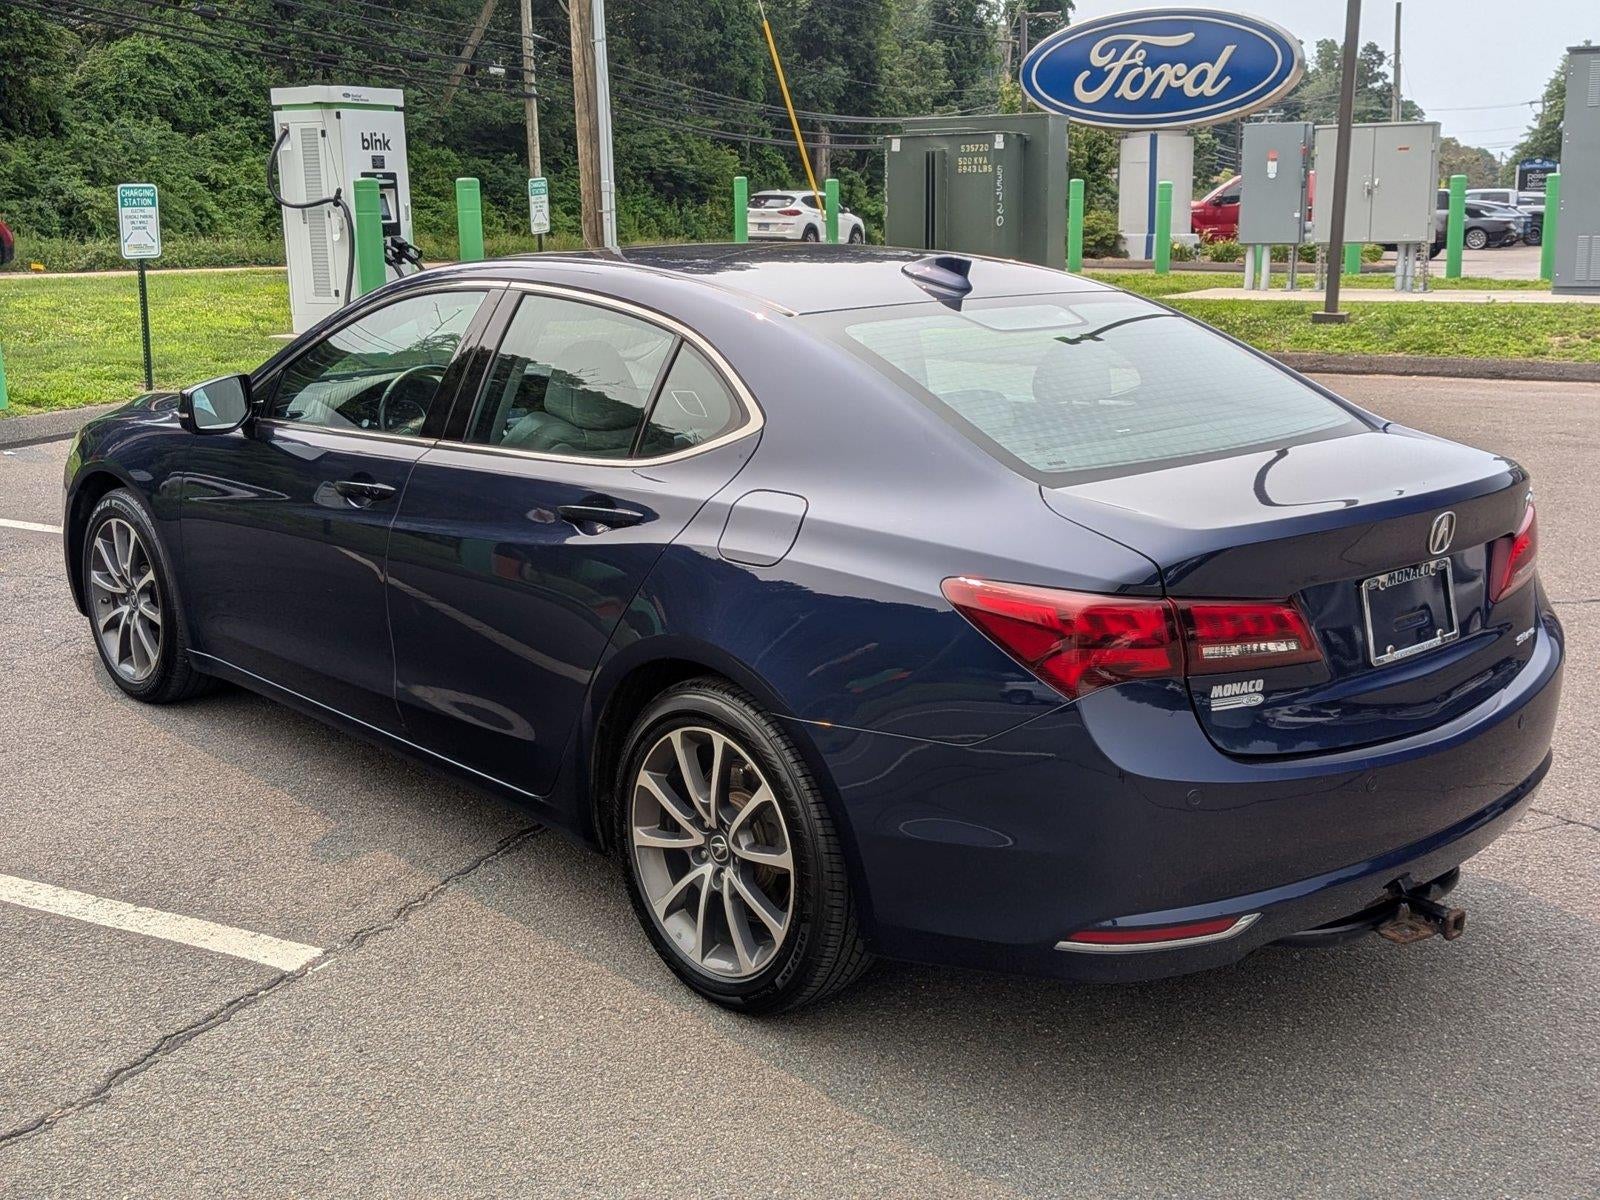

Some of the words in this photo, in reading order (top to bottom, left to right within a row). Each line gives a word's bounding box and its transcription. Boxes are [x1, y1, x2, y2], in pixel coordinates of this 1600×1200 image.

[1073, 32, 1238, 104] Ford
[361, 132, 392, 151] blink
[960, 144, 990, 153] 535720
[977, 164, 993, 173] LBS
[121, 188, 154, 197] CHARGING
[124, 198, 153, 207] STATION
[1386, 563, 1431, 585] MONACO
[1210, 679, 1264, 698] MONACO
